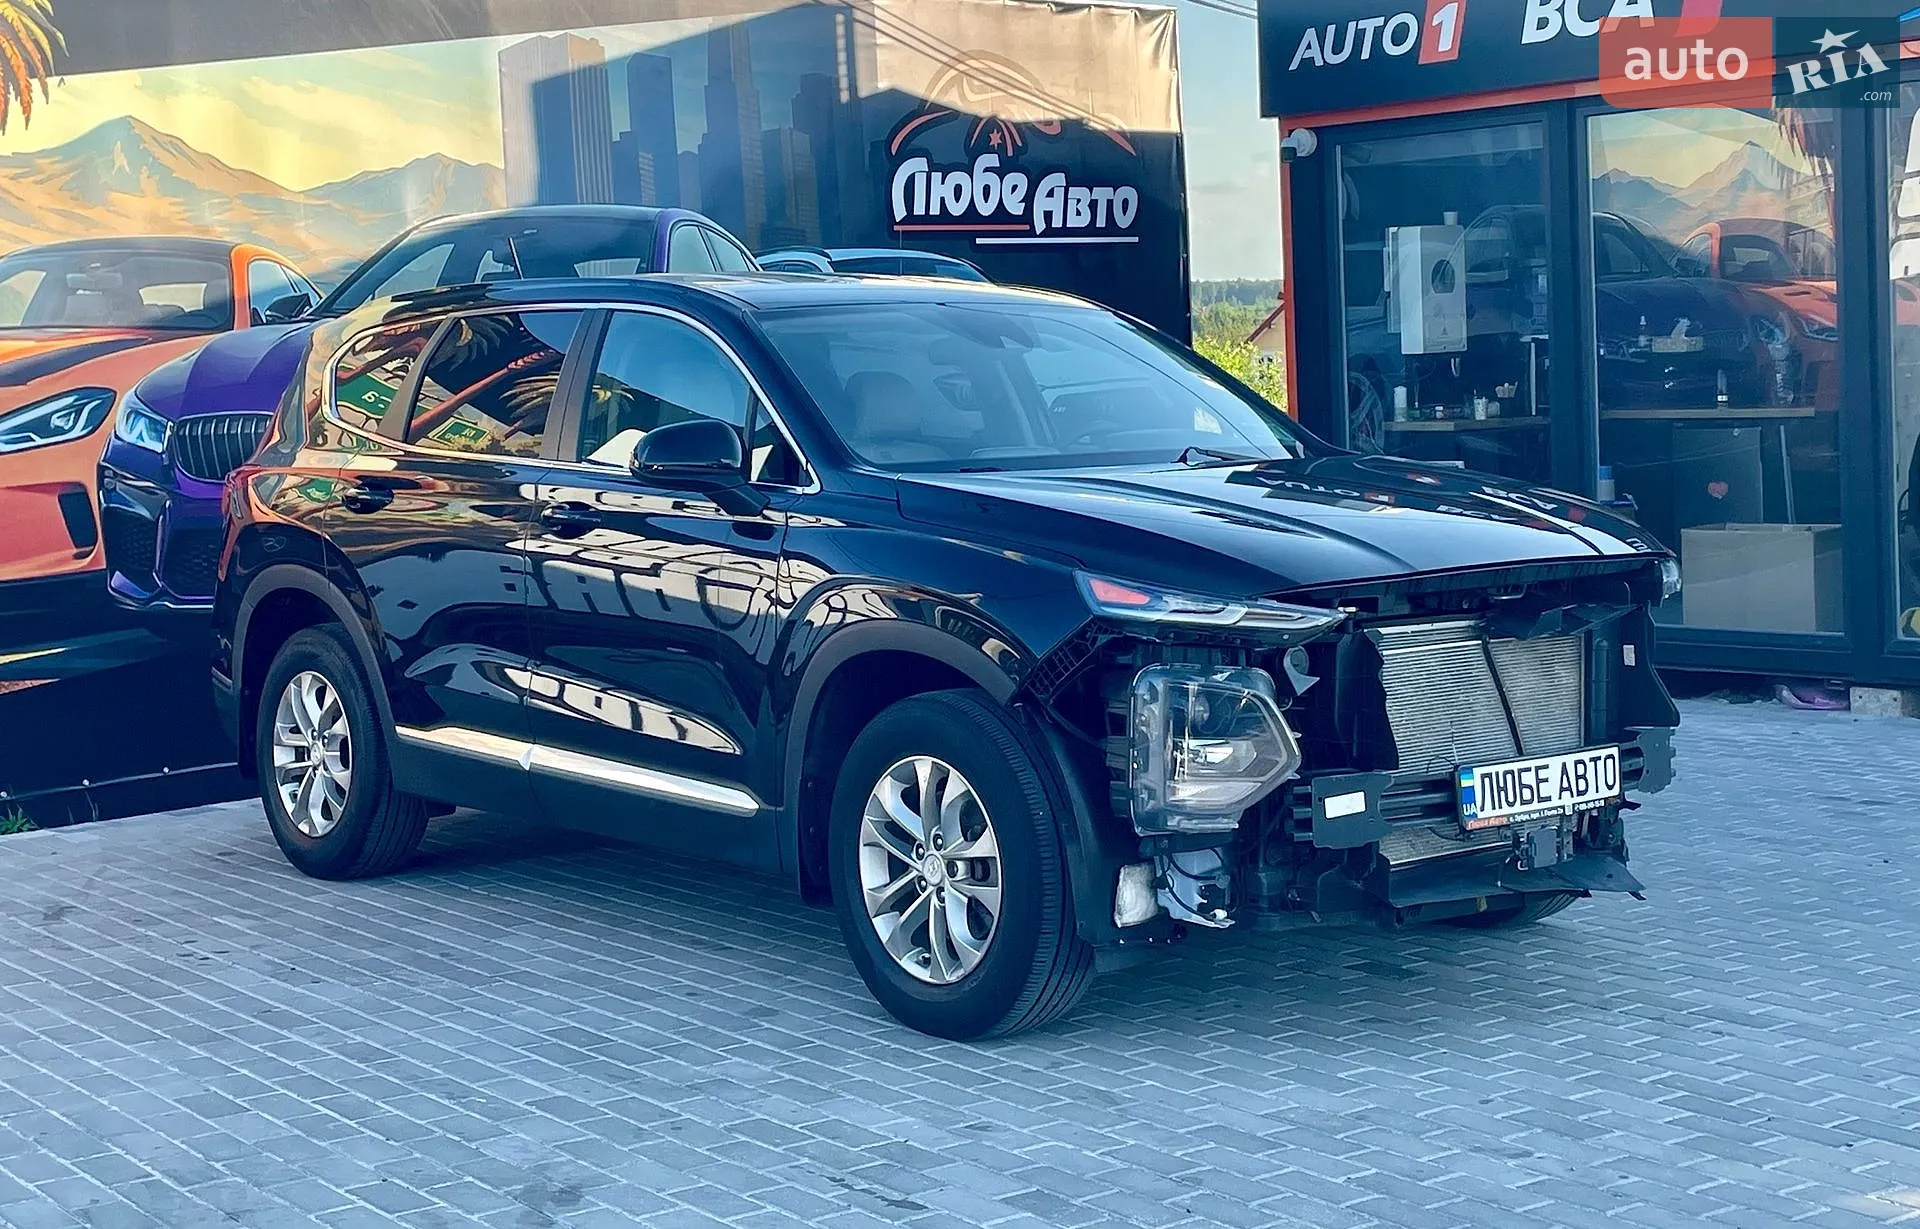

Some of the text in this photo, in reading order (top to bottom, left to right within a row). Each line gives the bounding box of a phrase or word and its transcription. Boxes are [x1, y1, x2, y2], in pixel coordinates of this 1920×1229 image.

[891, 153, 1139, 235] Любе Авто
[1463, 802, 1478, 816] UA
[1479, 753, 1617, 812] ЛЮБЕ АВТО
